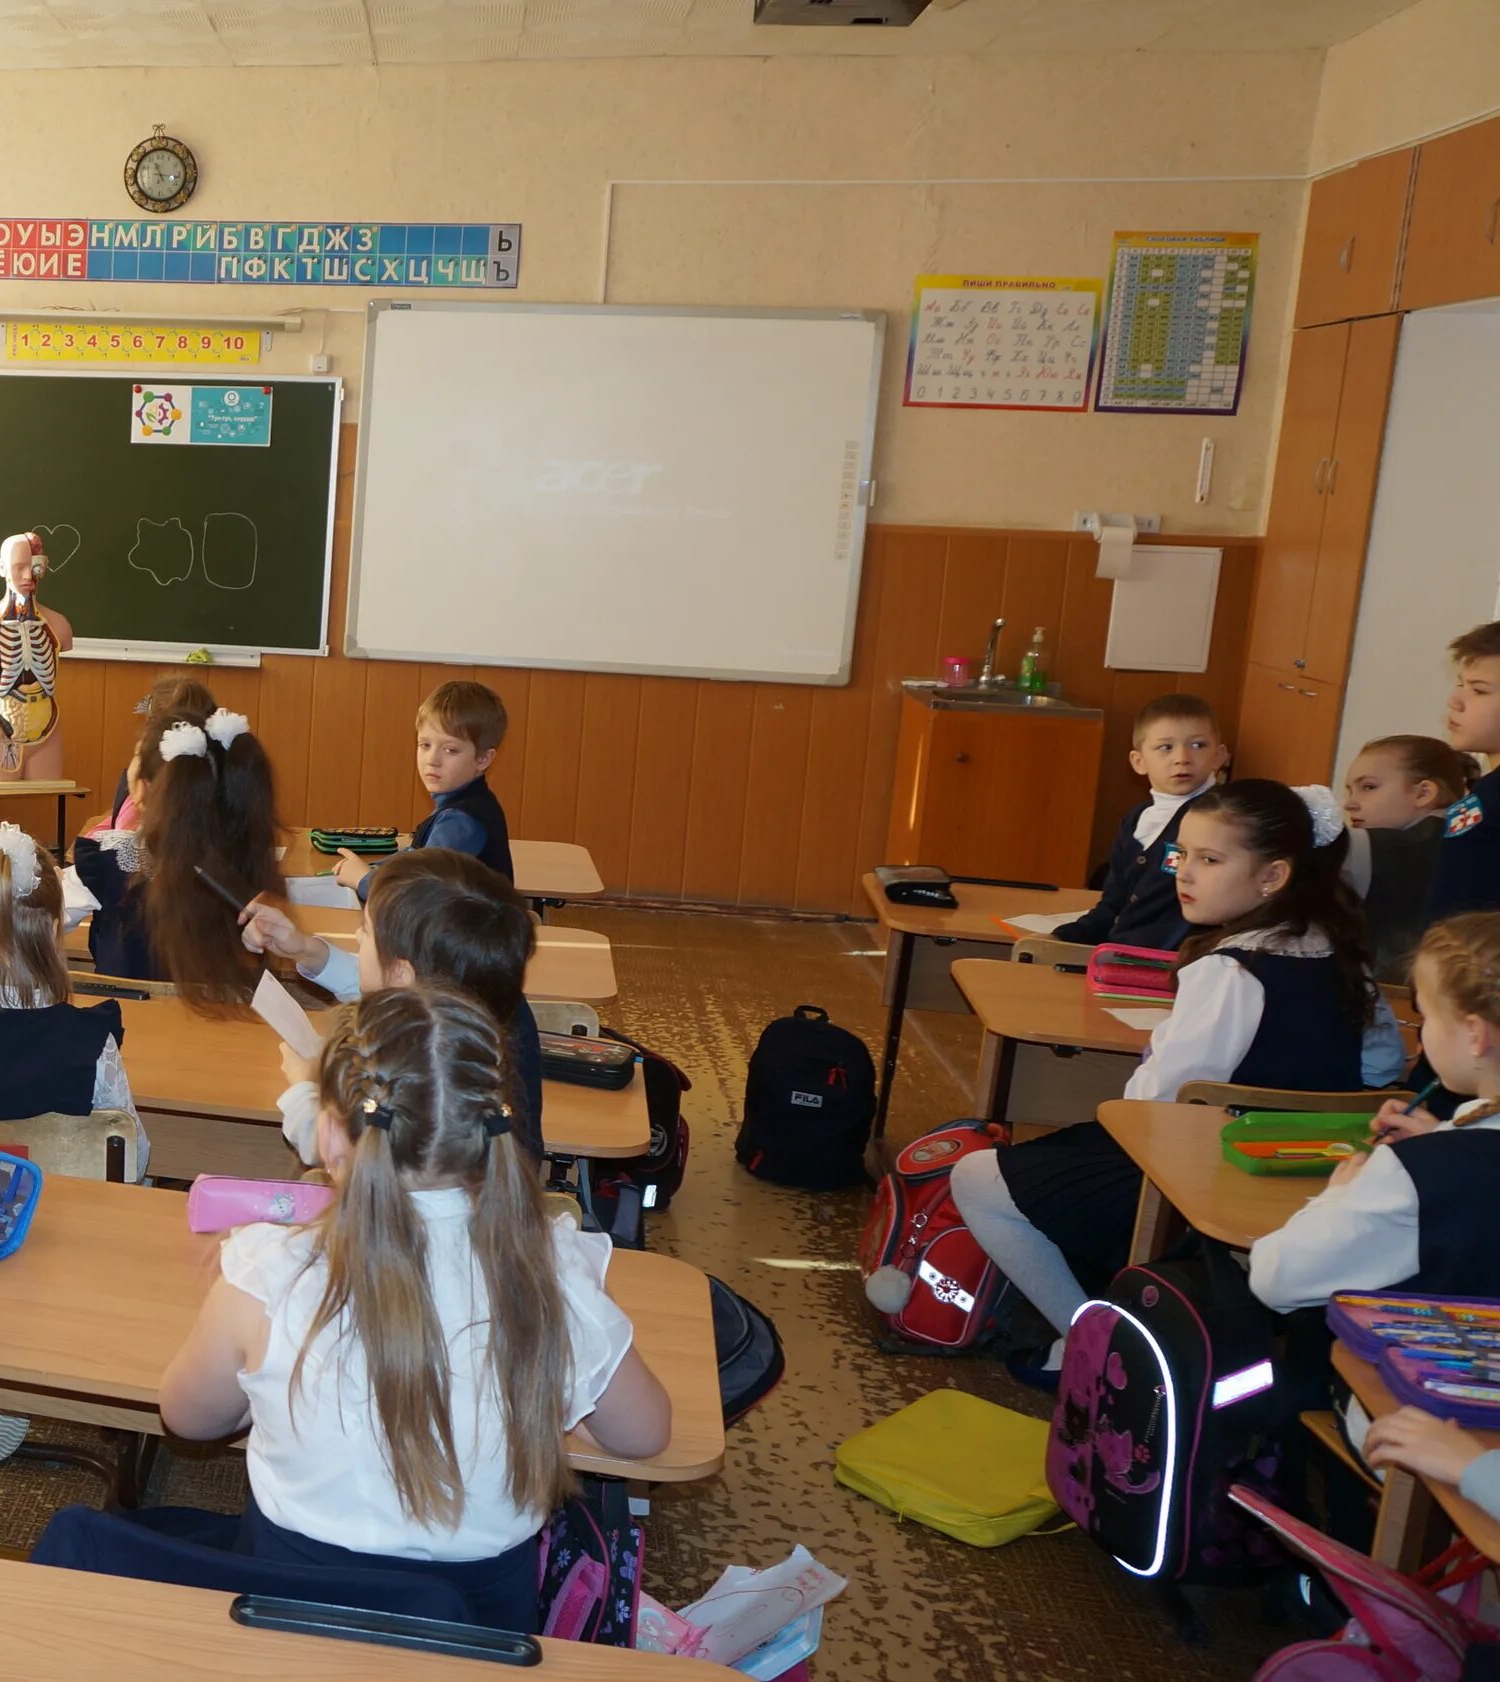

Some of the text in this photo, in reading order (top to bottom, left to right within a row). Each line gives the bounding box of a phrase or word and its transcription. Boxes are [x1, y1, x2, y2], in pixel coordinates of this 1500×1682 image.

[995, 280, 1056, 289] ПРАВИЛЬНО
[21, 333, 244, 350] 1 2 3 4 5 6 7 8 9 10
[535, 459, 664, 494] acer
[794, 1093, 820, 1104] FILA
